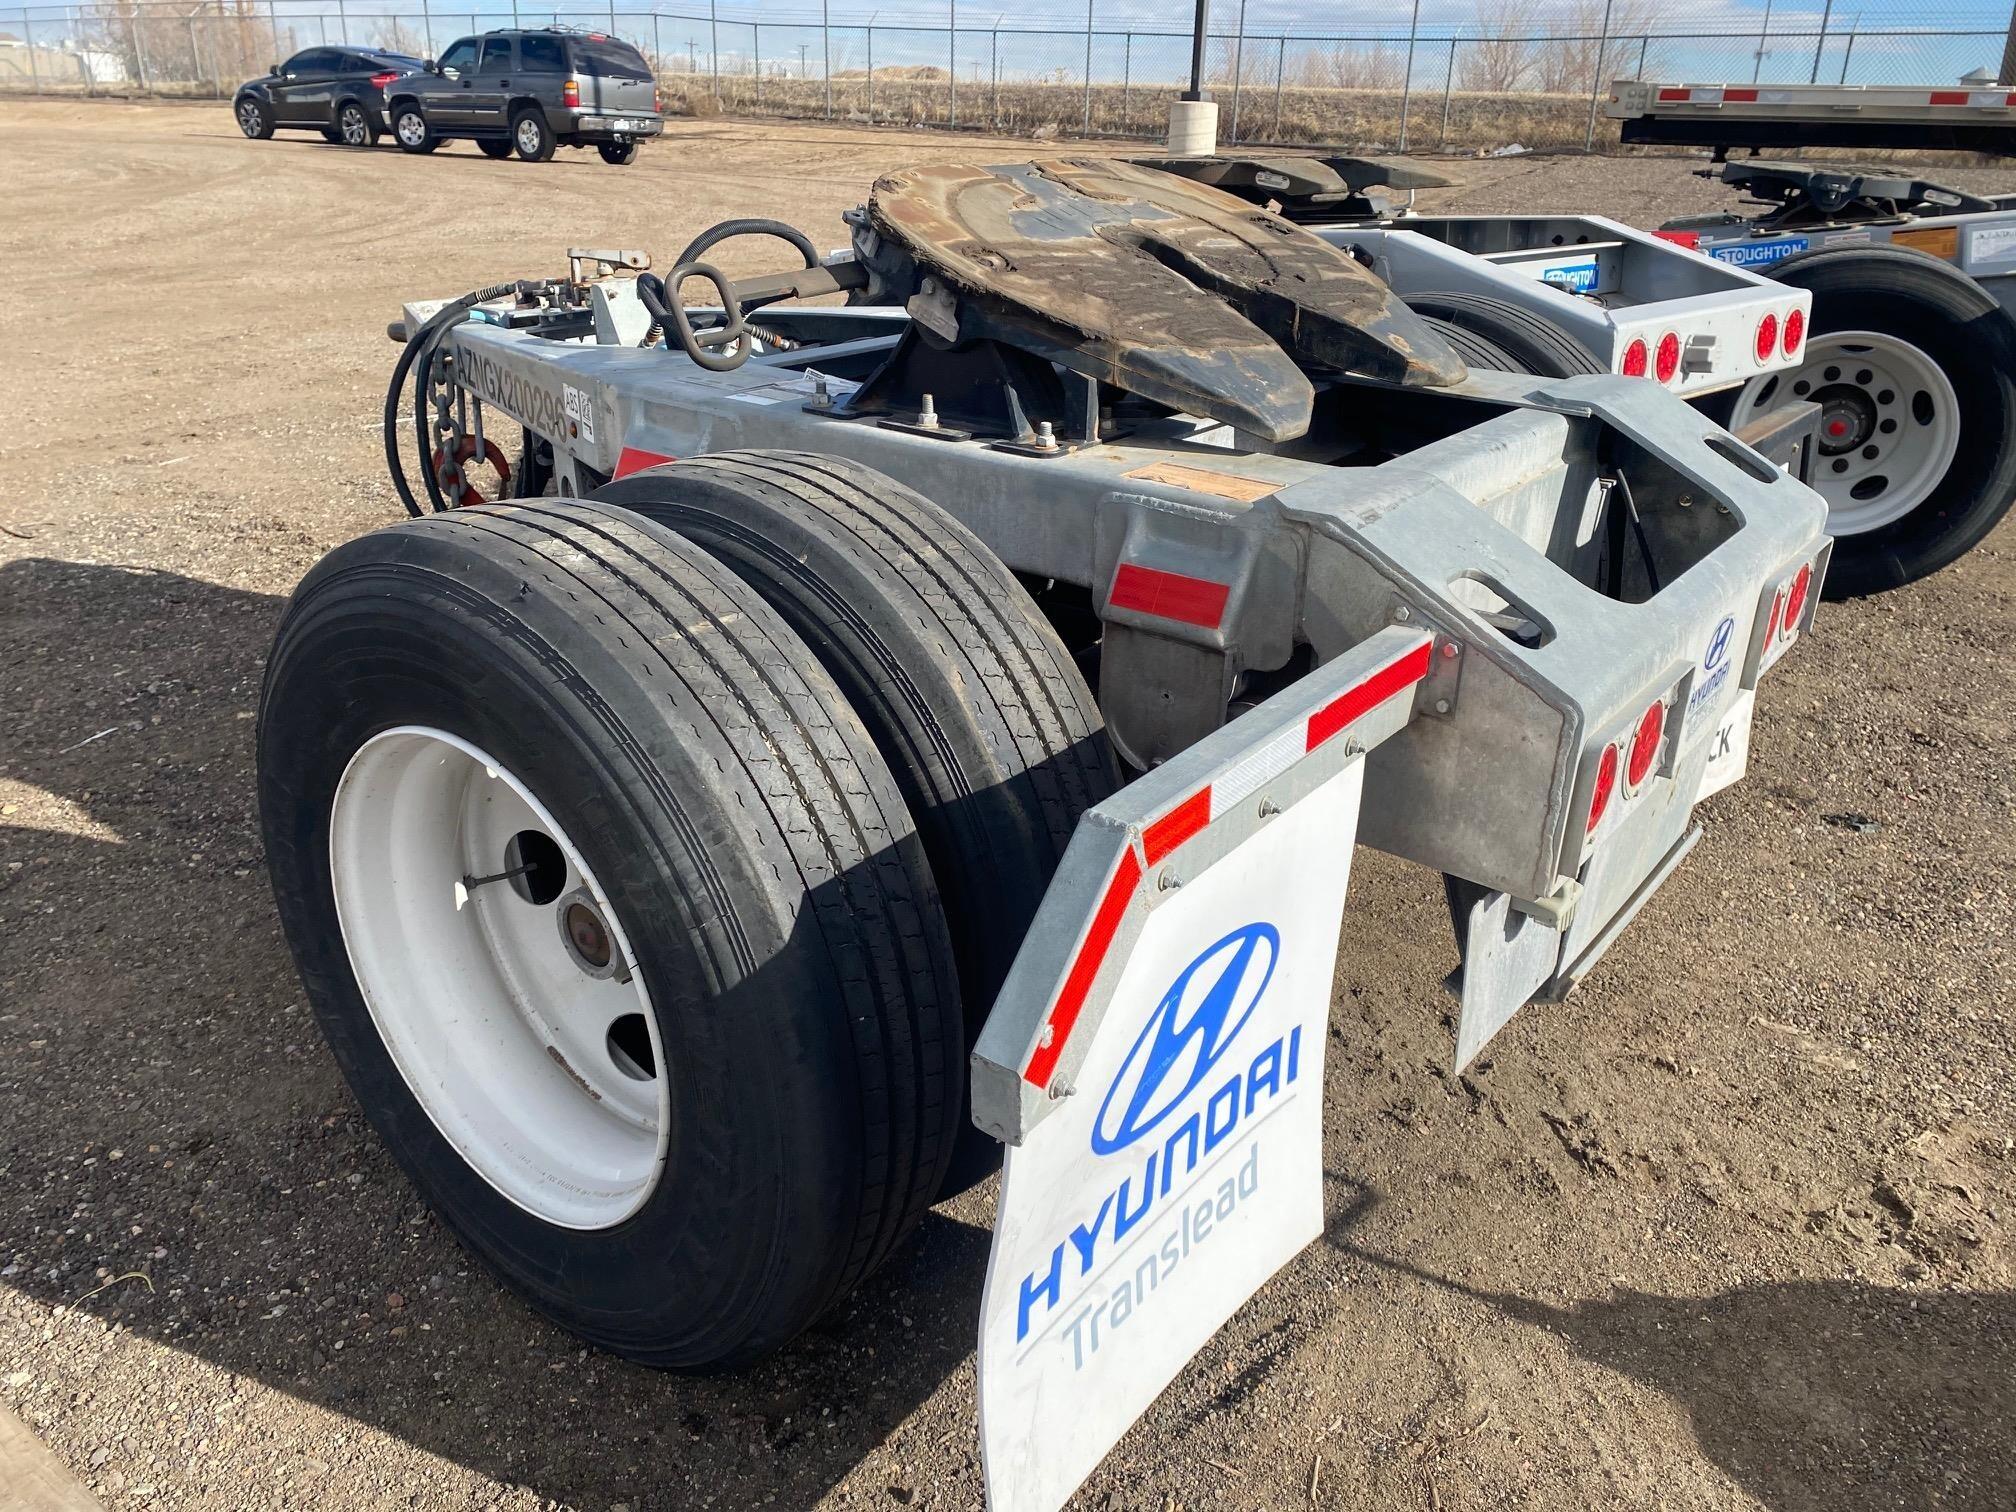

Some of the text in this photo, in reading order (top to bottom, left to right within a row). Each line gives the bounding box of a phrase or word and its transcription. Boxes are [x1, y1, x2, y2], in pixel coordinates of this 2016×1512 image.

[1714, 243, 1802, 265] STOUGHTON
[456, 343, 568, 444] AZNGX200296
[565, 391, 579, 415] ABS
[1016, 1023, 1302, 1345] HYUNDAI
[1061, 1142, 1259, 1371] Translead
